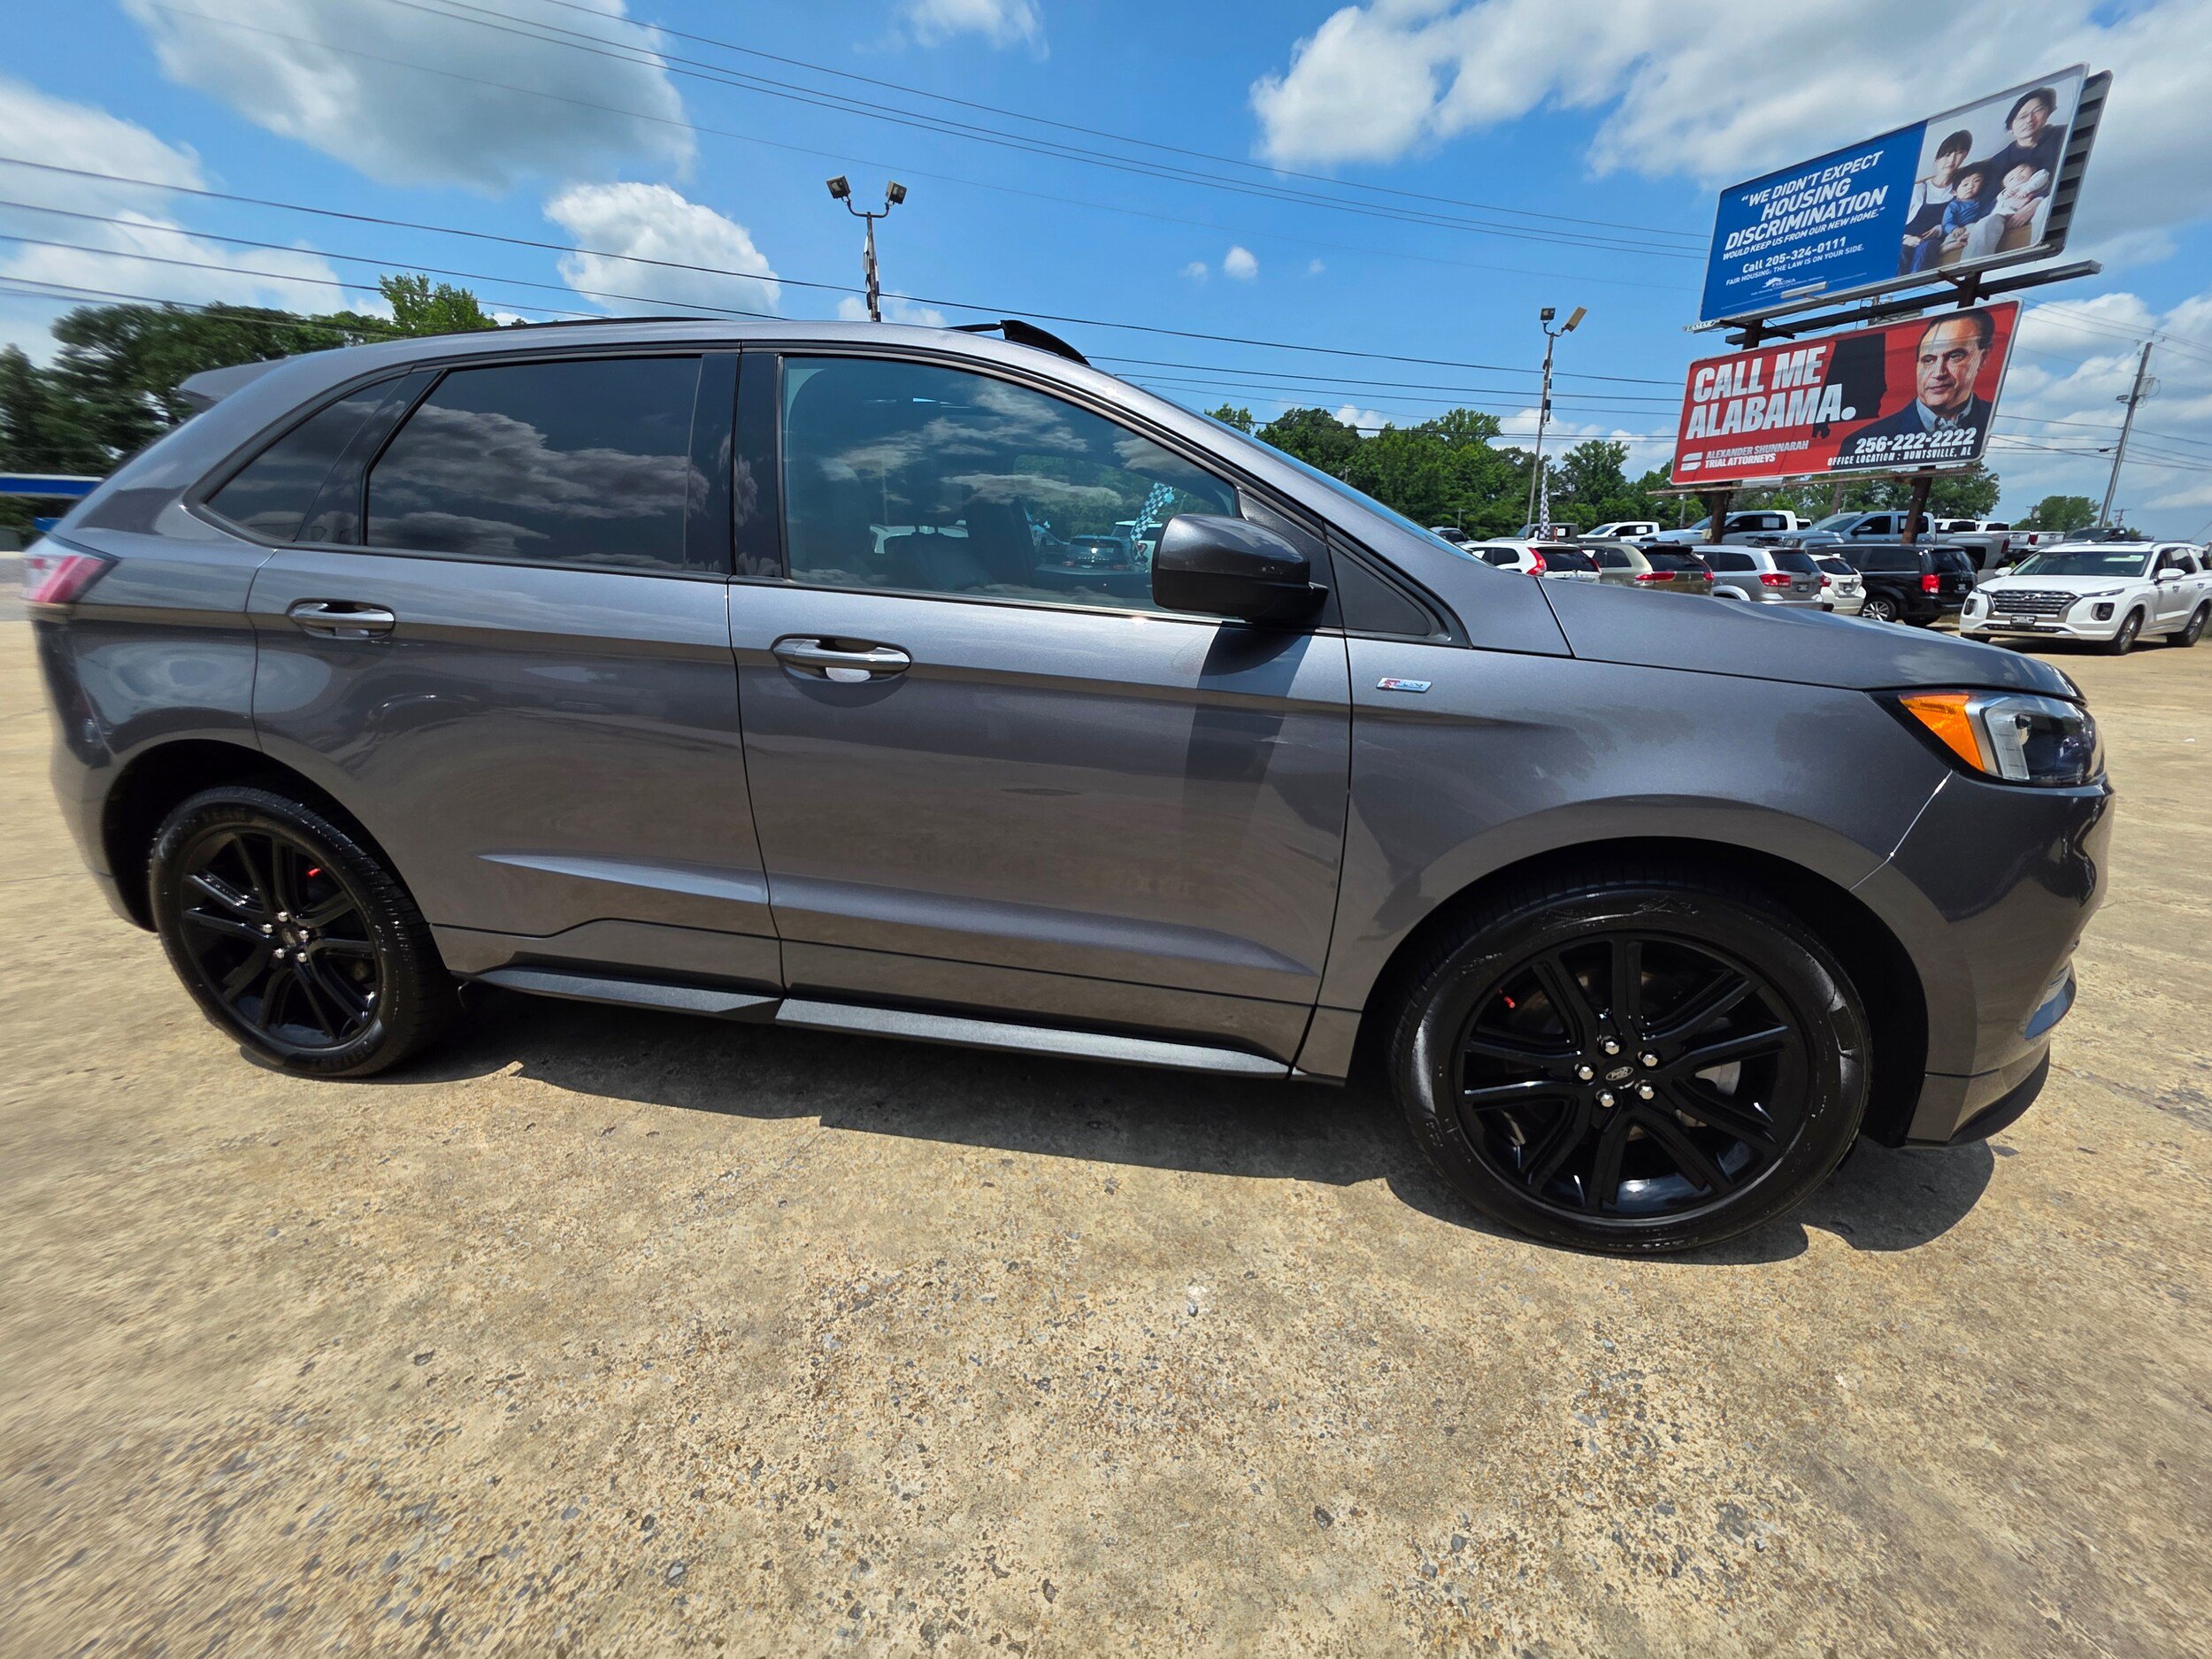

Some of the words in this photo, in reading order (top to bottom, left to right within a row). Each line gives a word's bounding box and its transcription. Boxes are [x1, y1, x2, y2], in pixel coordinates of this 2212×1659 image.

[1771, 172, 1821, 199] DIDN'T
[1821, 150, 1884, 183] EXPECT
[1724, 185, 1889, 250] DISCRIMINATION
[1761, 178, 1851, 221] HOUSING
[1723, 247, 1750, 260] WOULD
[1750, 241, 1771, 252] KEEP
[1772, 236, 1784, 246] US
[1784, 230, 1808, 242] FROM
[1809, 224, 1826, 235] OUR
[1828, 218, 1849, 230] NEW
[1742, 259, 1763, 273] Call
[1765, 236, 1847, 267] 205-324-0111
[1726, 277, 1740, 286] FAIR
[1741, 269, 1771, 281] HOUSING:
[1773, 264, 1786, 273] THE
[1787, 260, 1803, 269] LAW
[1824, 249, 1844, 259] YOUR
[1845, 243, 1863, 255] SIDE.
[1693, 357, 1764, 403] CALL
[1771, 345, 1827, 390] ME
[1686, 383, 1856, 440] ALABAMA.
[1705, 457, 1727, 468] TRIAL
[1727, 453, 1776, 466] ATTORNEYS
[1706, 446, 1754, 459] ALEXANDER
[1754, 440, 1809, 454] SHUNNARAH
[1827, 456, 1854, 466] OFFICE
[1855, 452, 1895, 464] LOCATION
[1903, 448, 1957, 460] HUNTSVILLE,
[1960, 446, 1971, 457] AL
[1855, 427, 1977, 454] 256-222-2222
